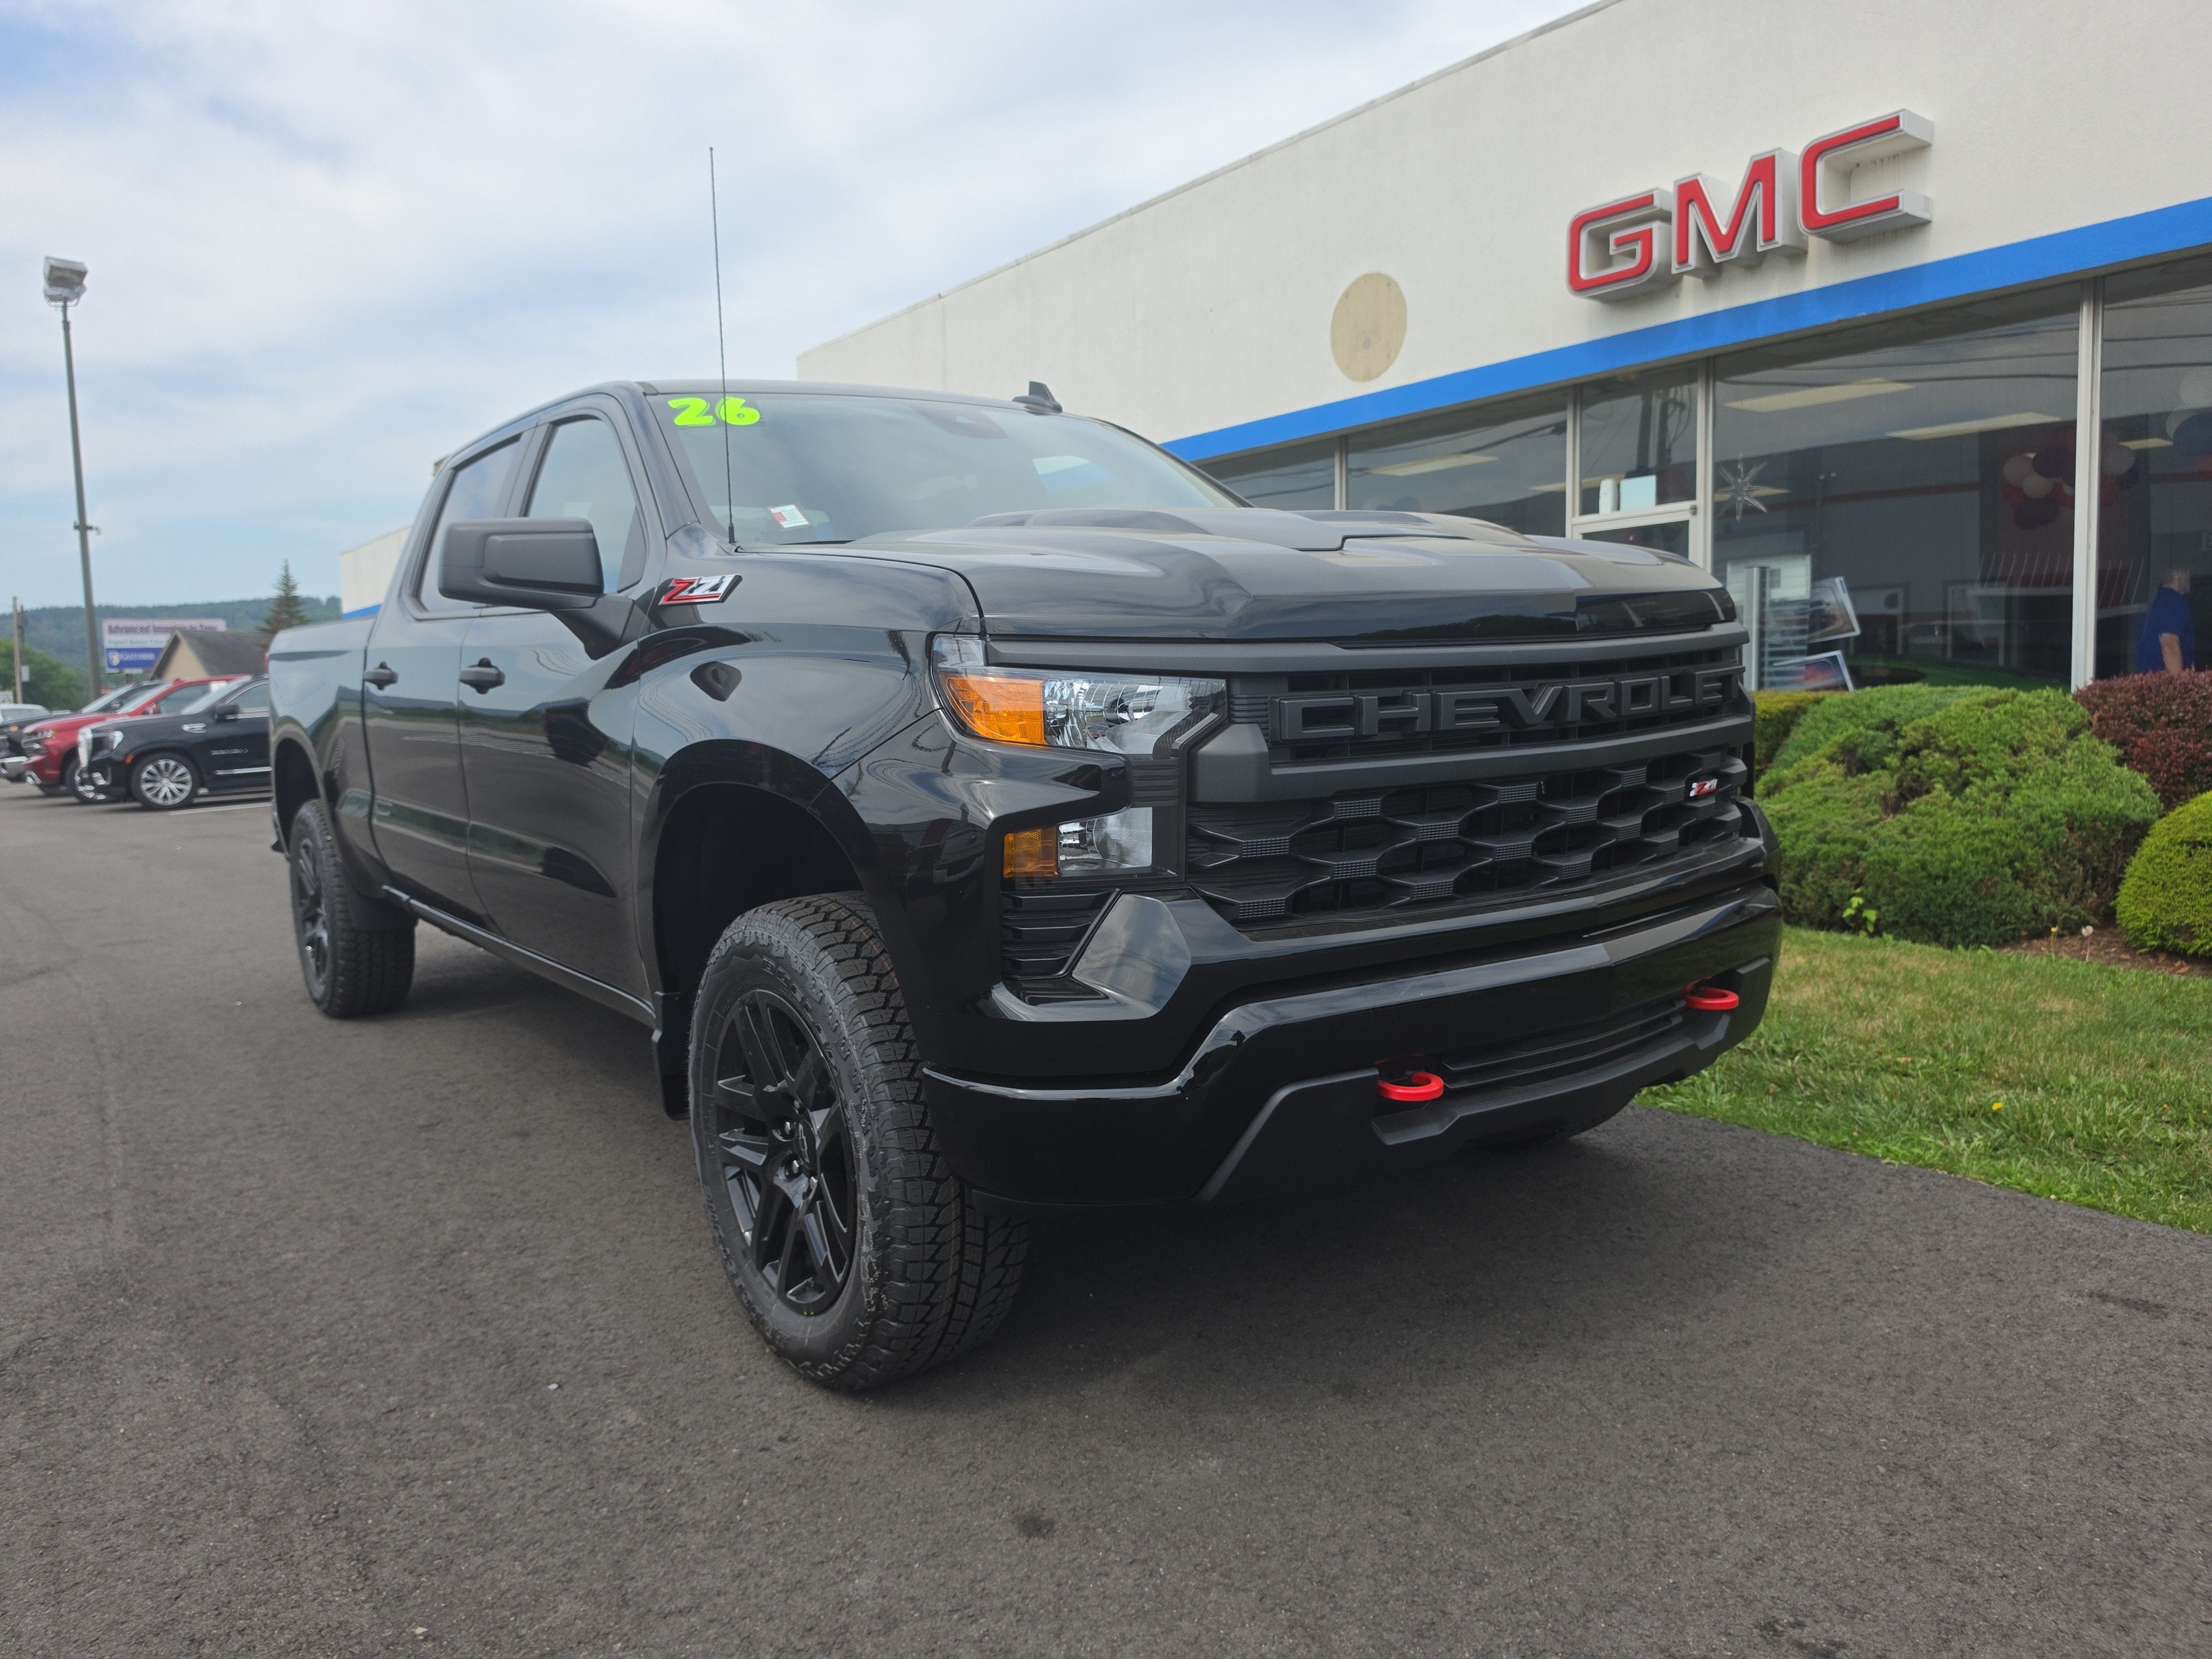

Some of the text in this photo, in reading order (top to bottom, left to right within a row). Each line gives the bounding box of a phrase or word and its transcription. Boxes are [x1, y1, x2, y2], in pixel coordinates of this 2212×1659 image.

[1567, 108, 1924, 298] GMC
[667, 397, 761, 427] 26
[659, 575, 741, 606] Z71
